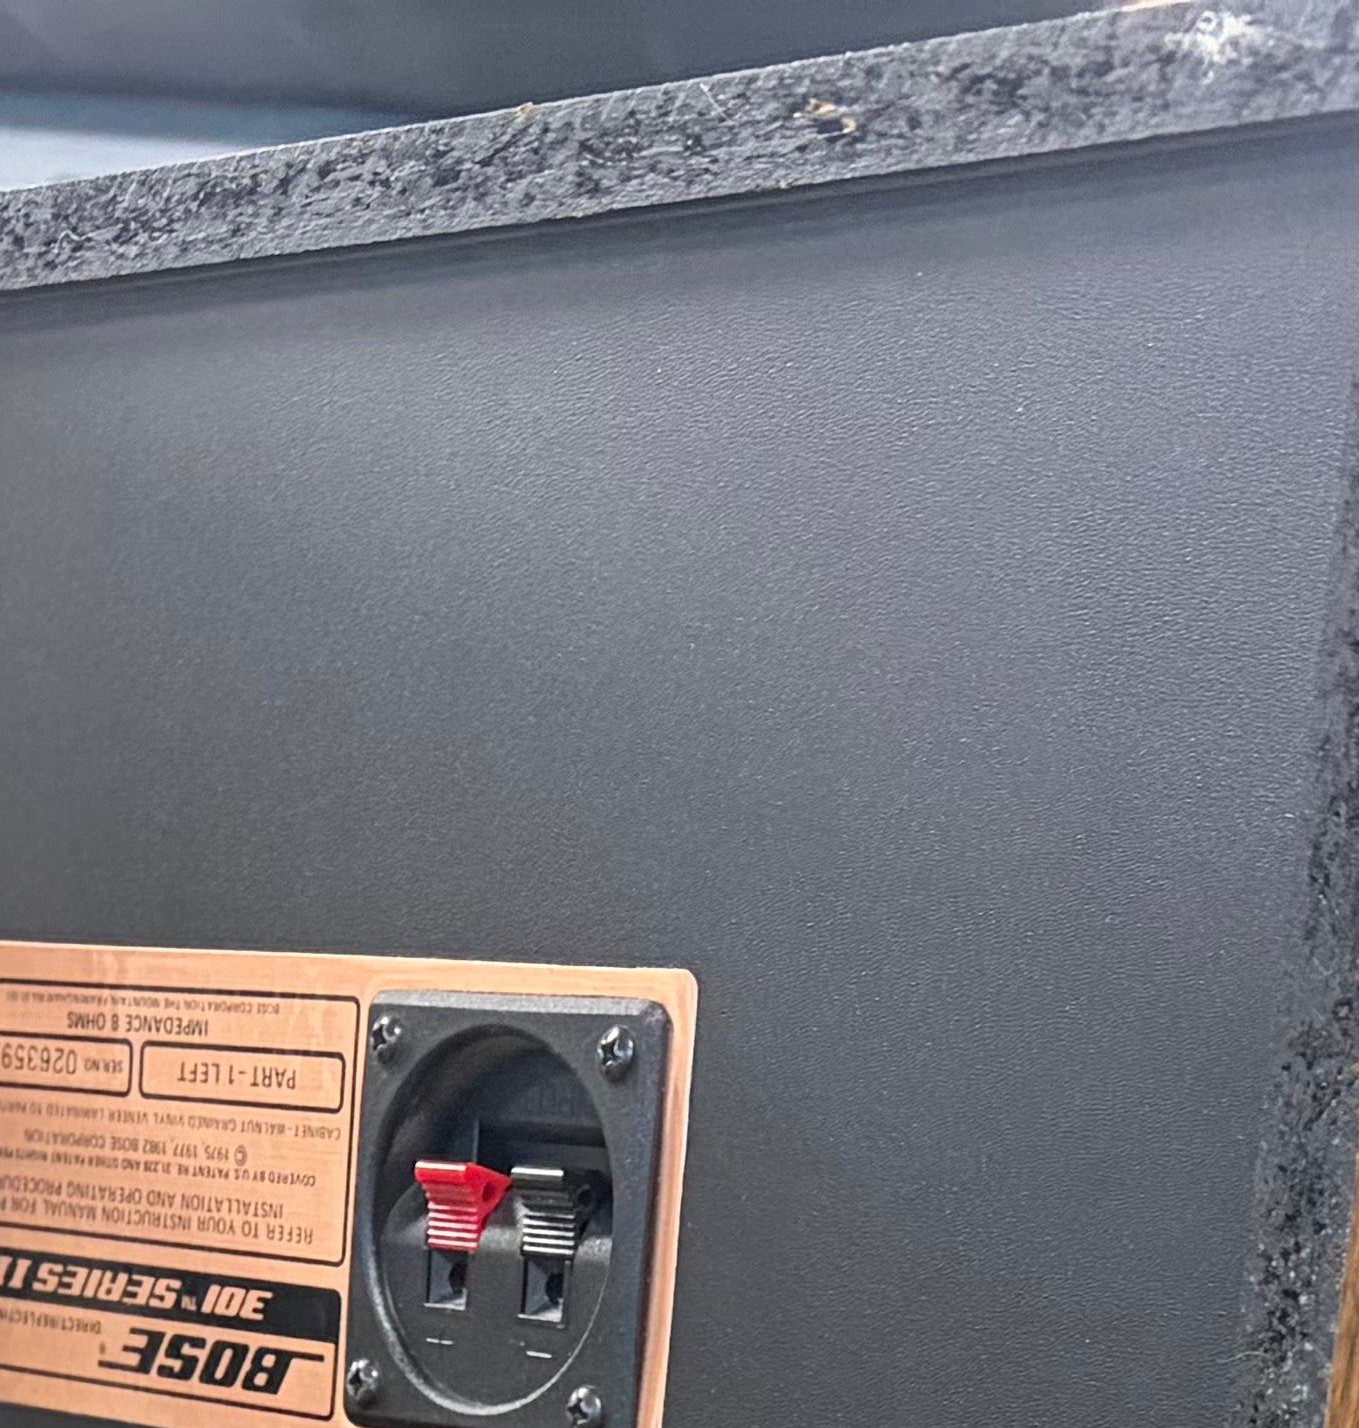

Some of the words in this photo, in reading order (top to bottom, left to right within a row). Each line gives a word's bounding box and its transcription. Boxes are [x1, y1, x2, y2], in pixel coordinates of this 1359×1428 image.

[66, 1010, 106, 1030] OHMS
[110, 1013, 119, 1031] 8
[123, 1014, 208, 1037] IMPEDANCE
[176, 1060, 220, 1084] LEFT
[142, 1138, 167, 1156] 1982
[192, 1163, 230, 1180] PATENT
[65, 1180, 143, 1206] OPERATING
[145, 1189, 176, 1209] AND
[10, 1195, 37, 1214] FOR
[41, 1198, 97, 1220] MANUAL
[179, 1192, 283, 1220] INSTALLATION
[100, 1204, 192, 1231] INSTRUCTION
[195, 1214, 236, 1236] YOUR
[240, 1219, 259, 1239] TO
[264, 1221, 313, 1245] REFER
[31, 1261, 182, 1309] SERIES
[97, 1327, 325, 1395] BOSE
